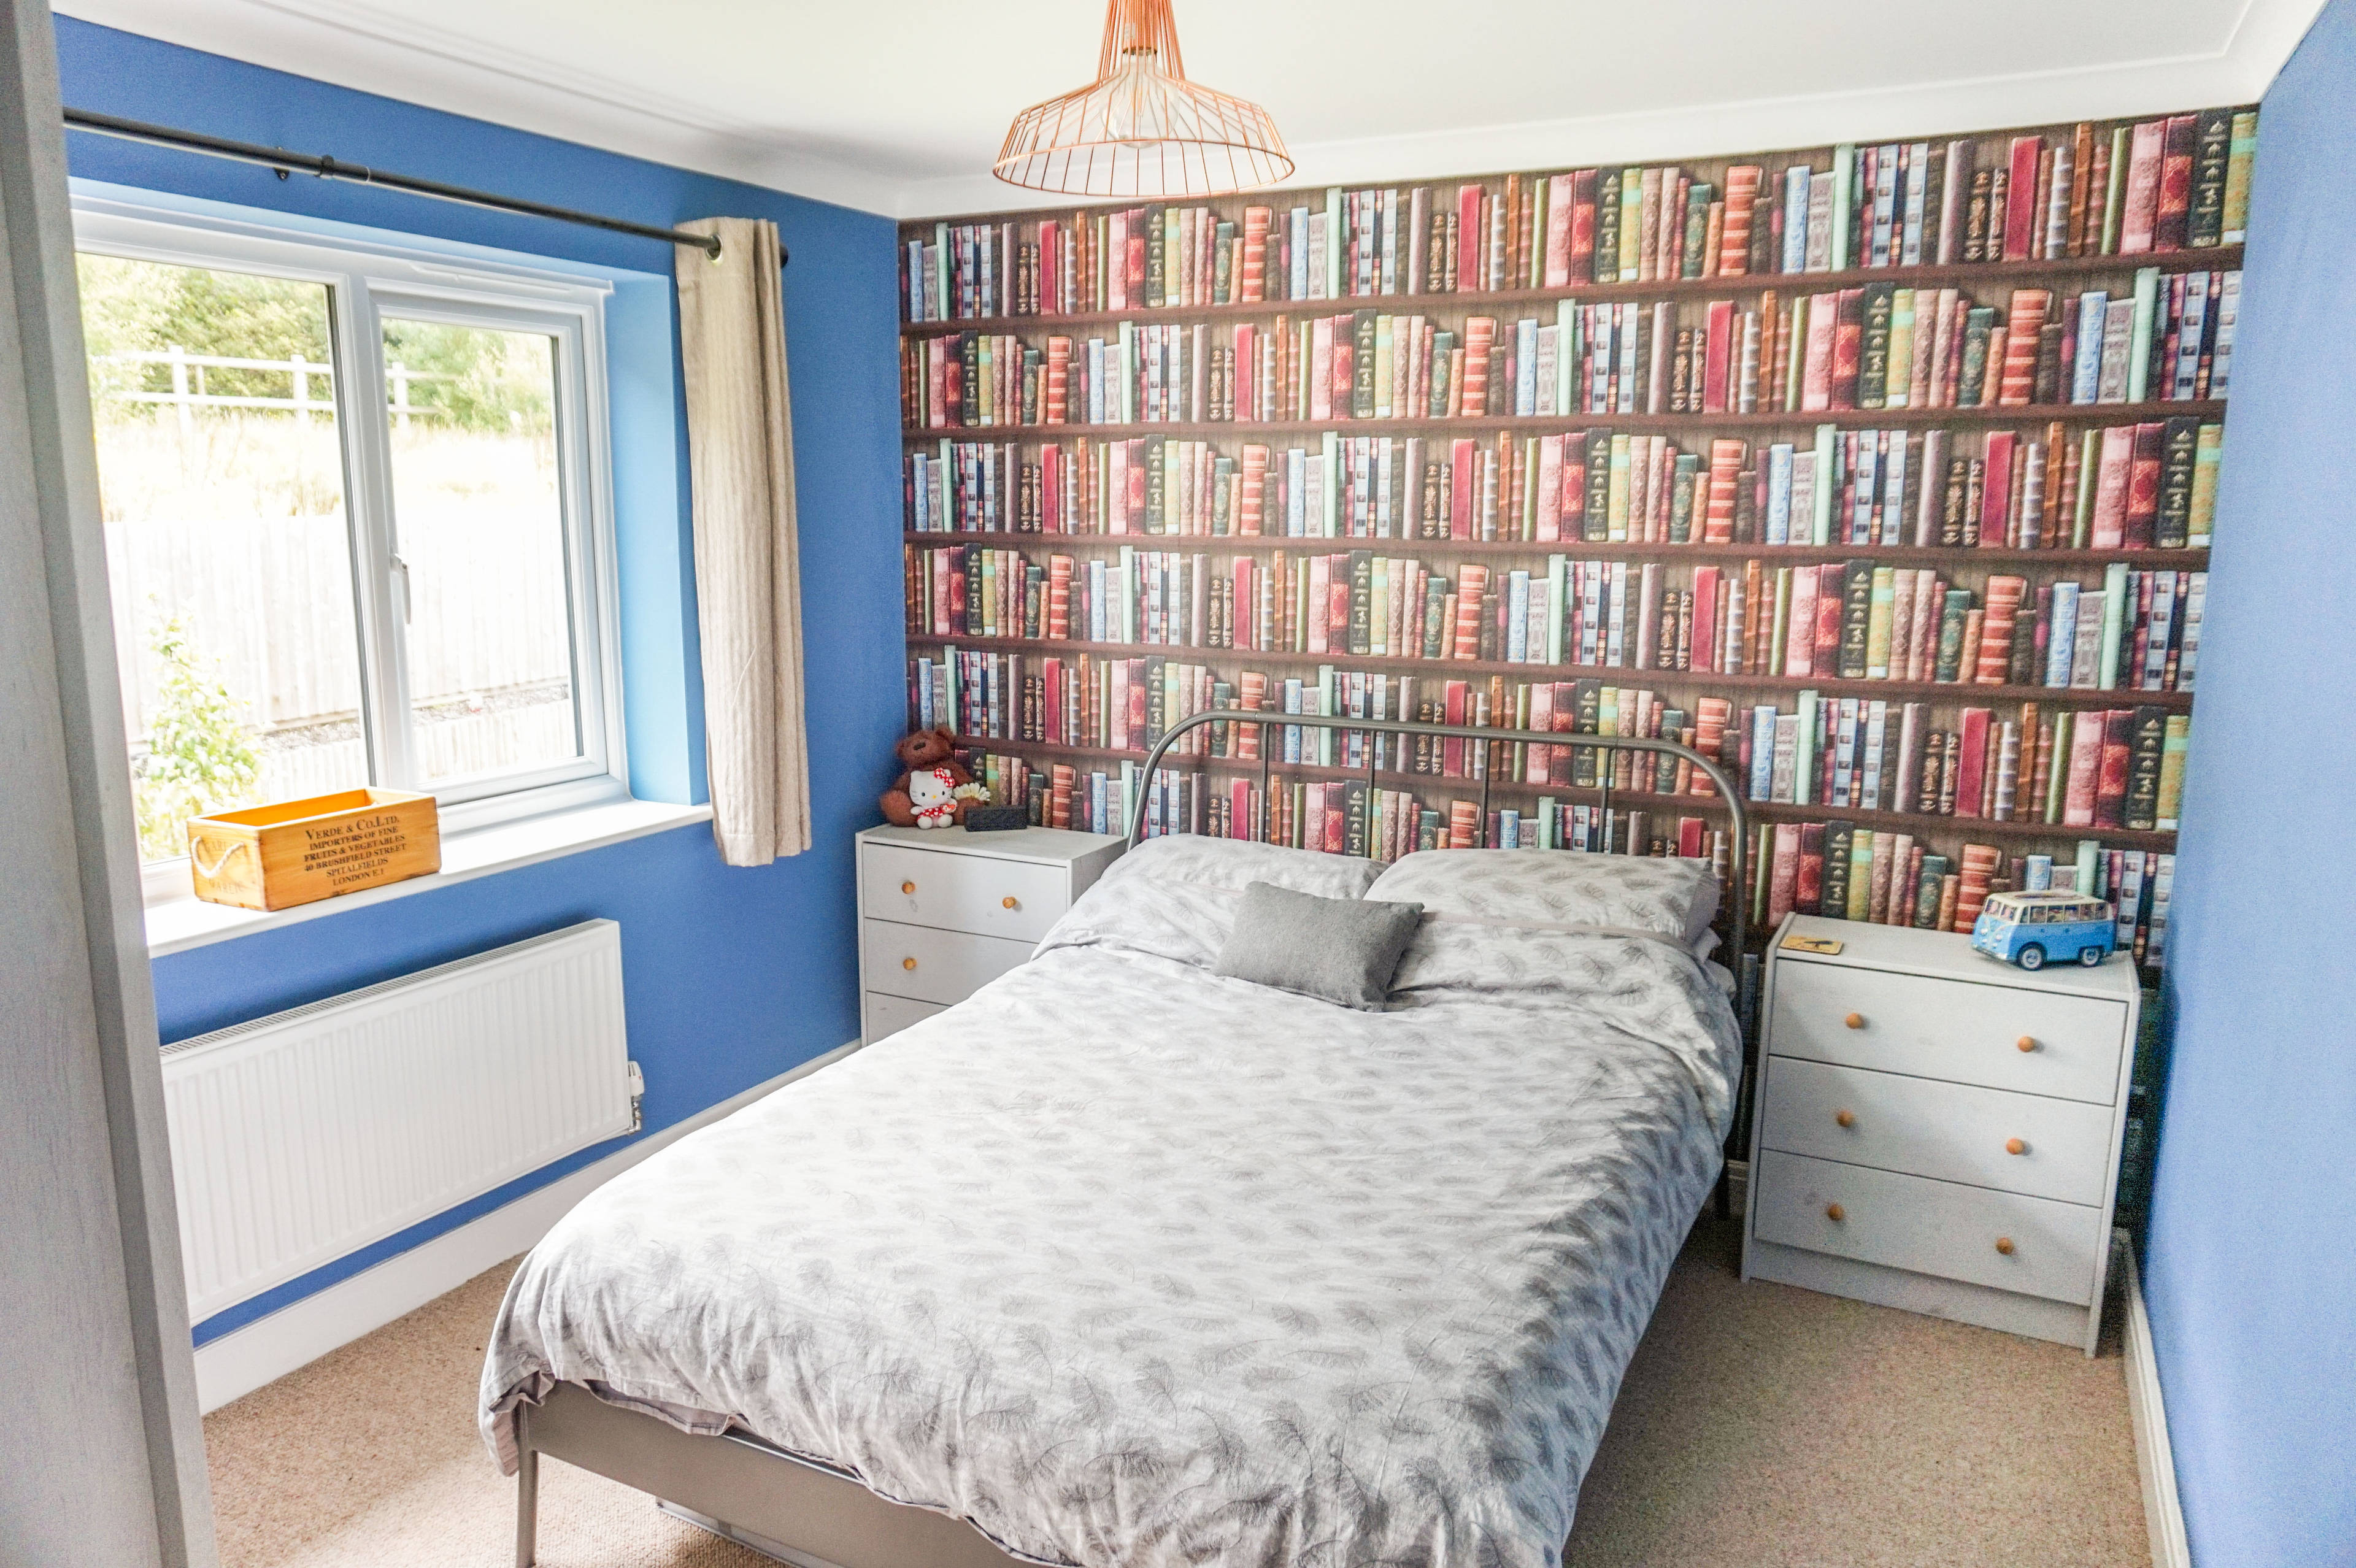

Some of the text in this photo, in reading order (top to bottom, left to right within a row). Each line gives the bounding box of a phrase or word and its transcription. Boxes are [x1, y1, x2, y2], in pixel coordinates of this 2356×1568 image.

[306, 826, 344, 840] VERDE
[346, 824, 353, 833] &
[309, 826, 399, 851] IMPORTERS OF FINE
[304, 848, 337, 862] FRUITS
[348, 834, 406, 853] VEGETABLES
[316, 851, 372, 869] BRUSHFIELD
[374, 843, 407, 856] STREET
[326, 857, 388, 877] SPITALFIELDS
[333, 873, 370, 886] LONDON
